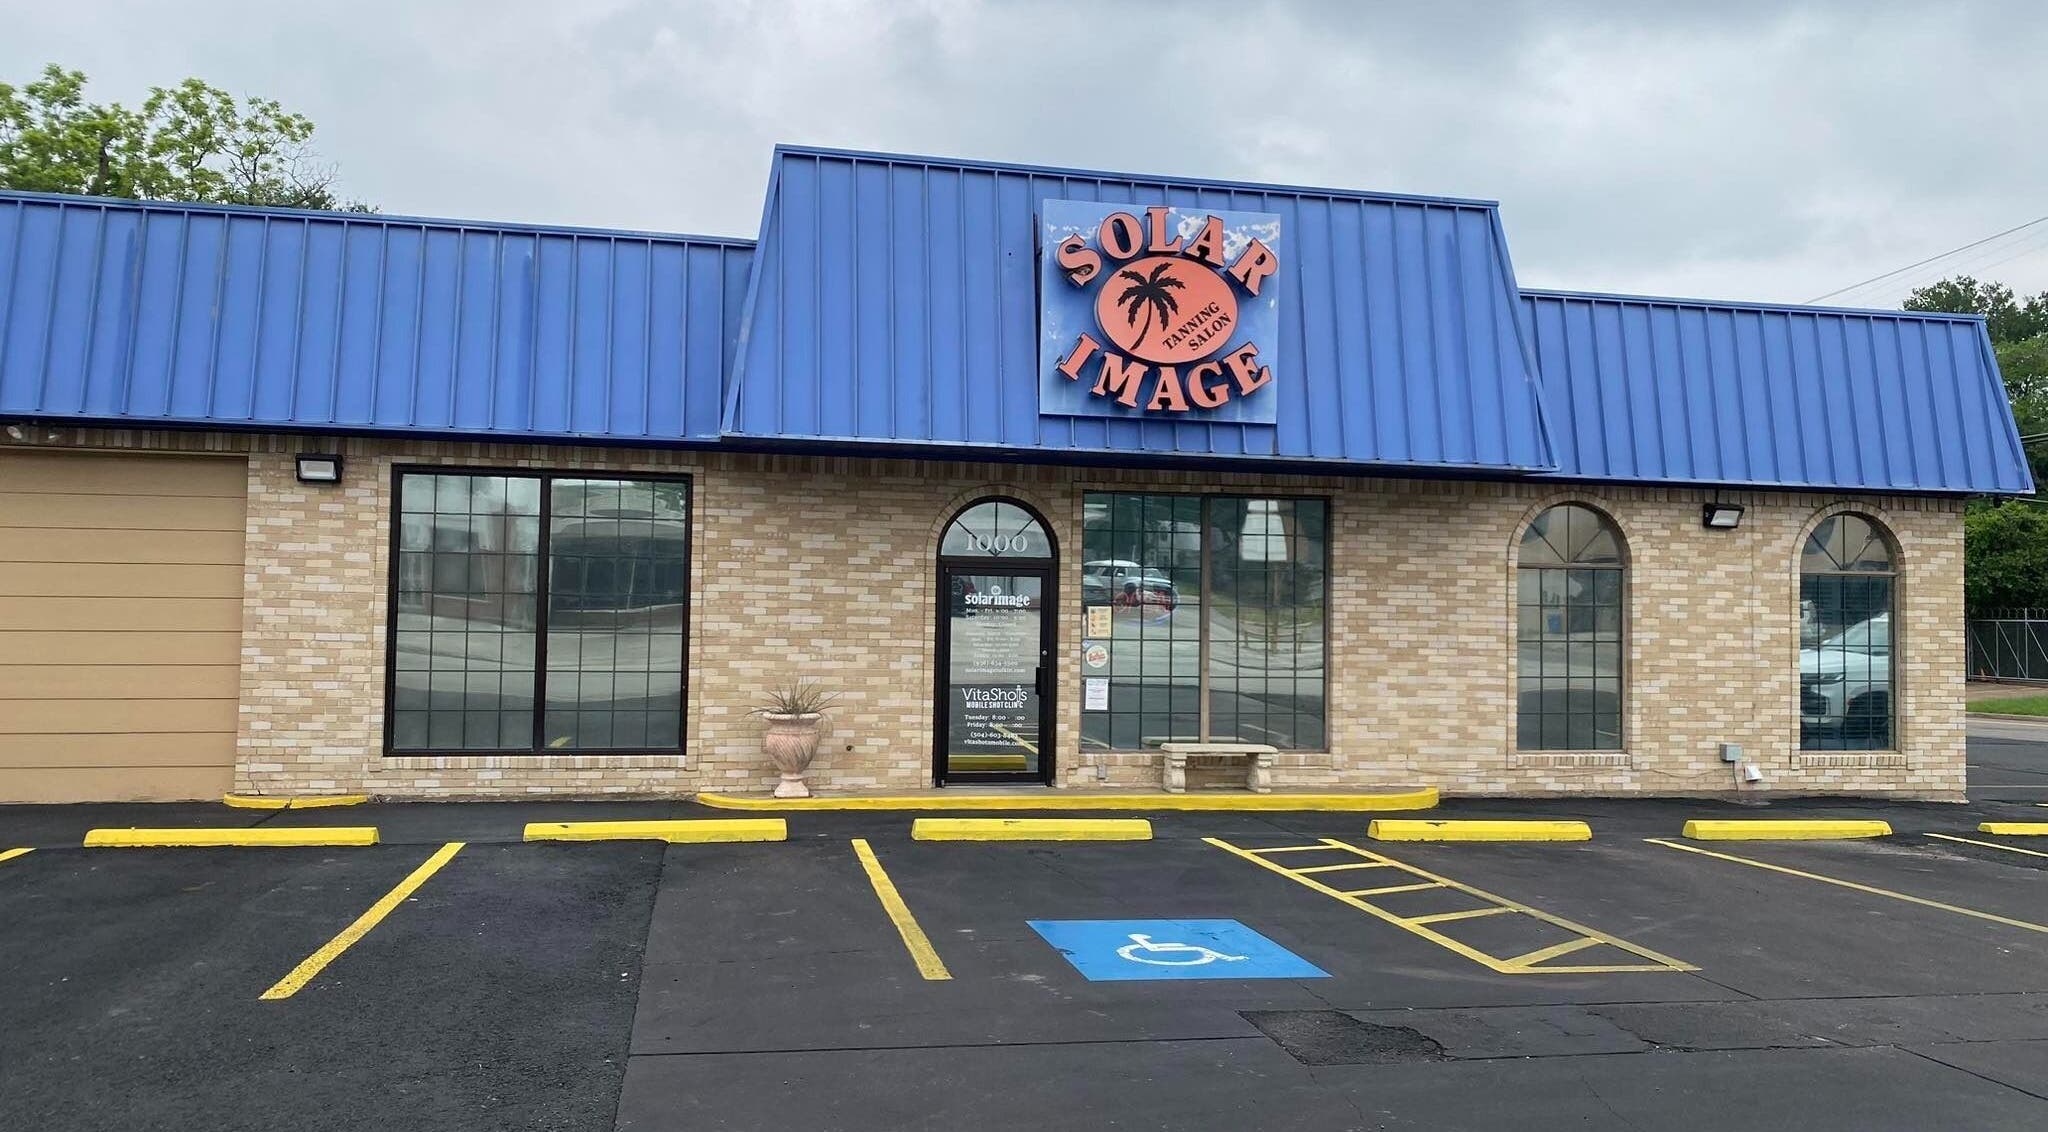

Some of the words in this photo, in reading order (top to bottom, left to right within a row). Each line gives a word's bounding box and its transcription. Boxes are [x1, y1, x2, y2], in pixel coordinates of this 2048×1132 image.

[1057, 206, 1278, 296] SOLAR
[1162, 301, 1220, 350] TANNING
[1188, 312, 1232, 351] SALON
[1059, 333, 1272, 411] IMAGE
[966, 533, 1028, 552] 1000
[962, 685, 1028, 703] VitaShots
[966, 701, 988, 709] MOBILE
[989, 701, 1004, 709] SHOT
